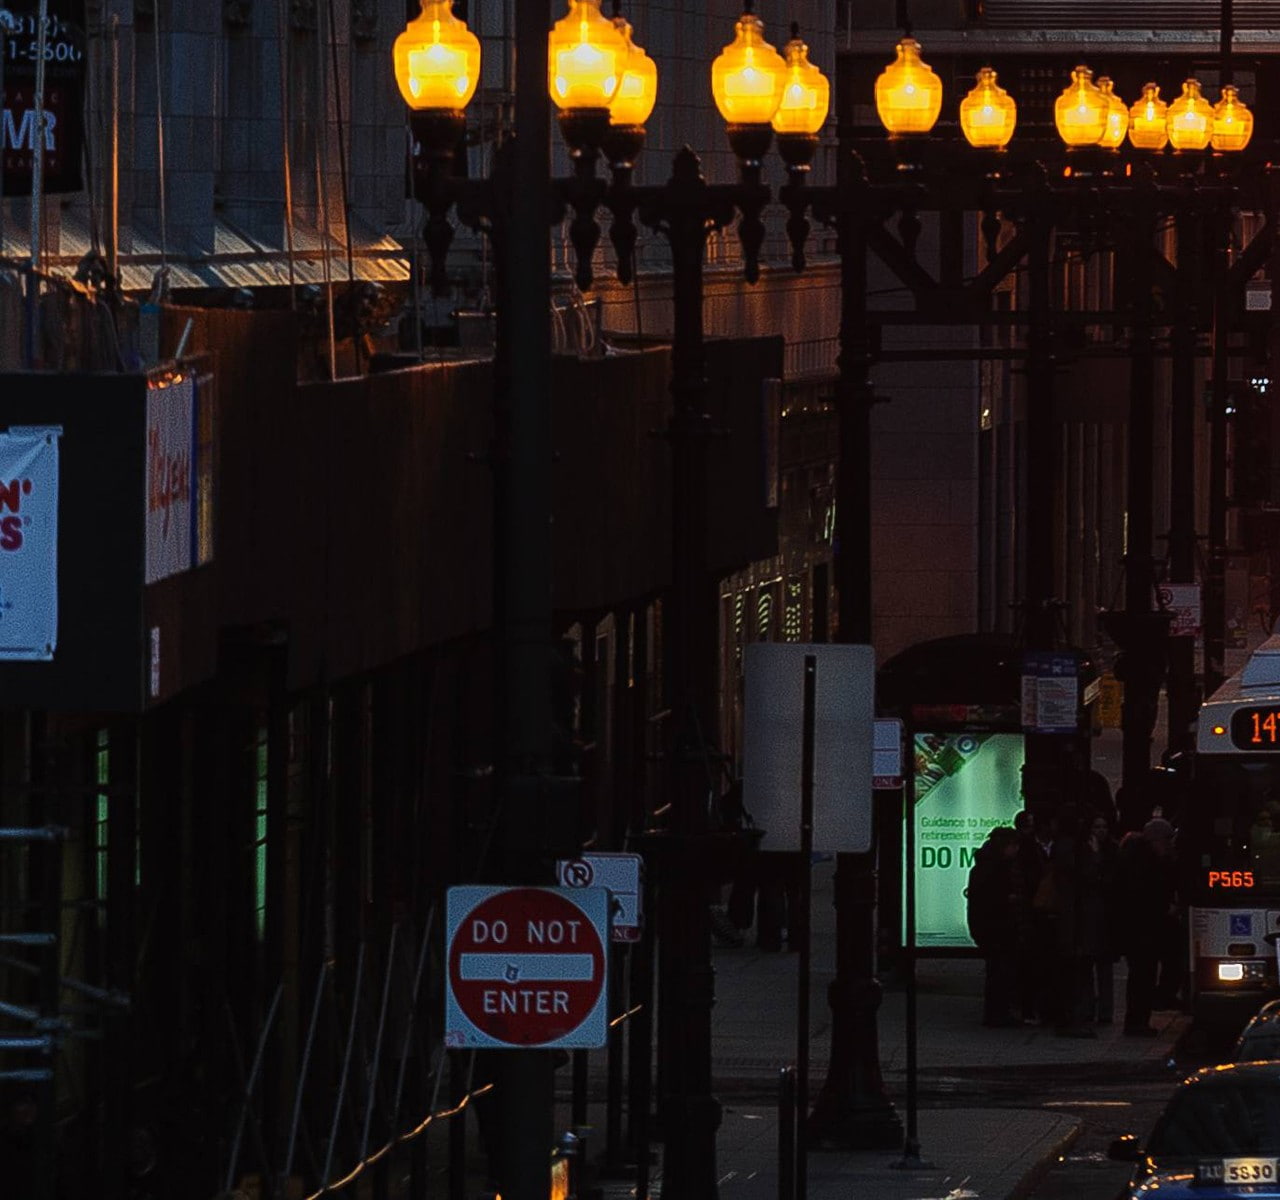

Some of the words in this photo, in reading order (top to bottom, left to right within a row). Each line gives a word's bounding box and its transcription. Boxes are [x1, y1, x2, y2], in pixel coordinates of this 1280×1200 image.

[921, 816, 966, 829] Guidance
[968, 817, 979, 828] to
[921, 831, 970, 841] retirement
[922, 846, 952, 869] DO
[1208, 871, 1255, 888] P565
[472, 920, 509, 944] DO
[527, 920, 581, 944] NOT
[483, 990, 570, 1015] ENTER
